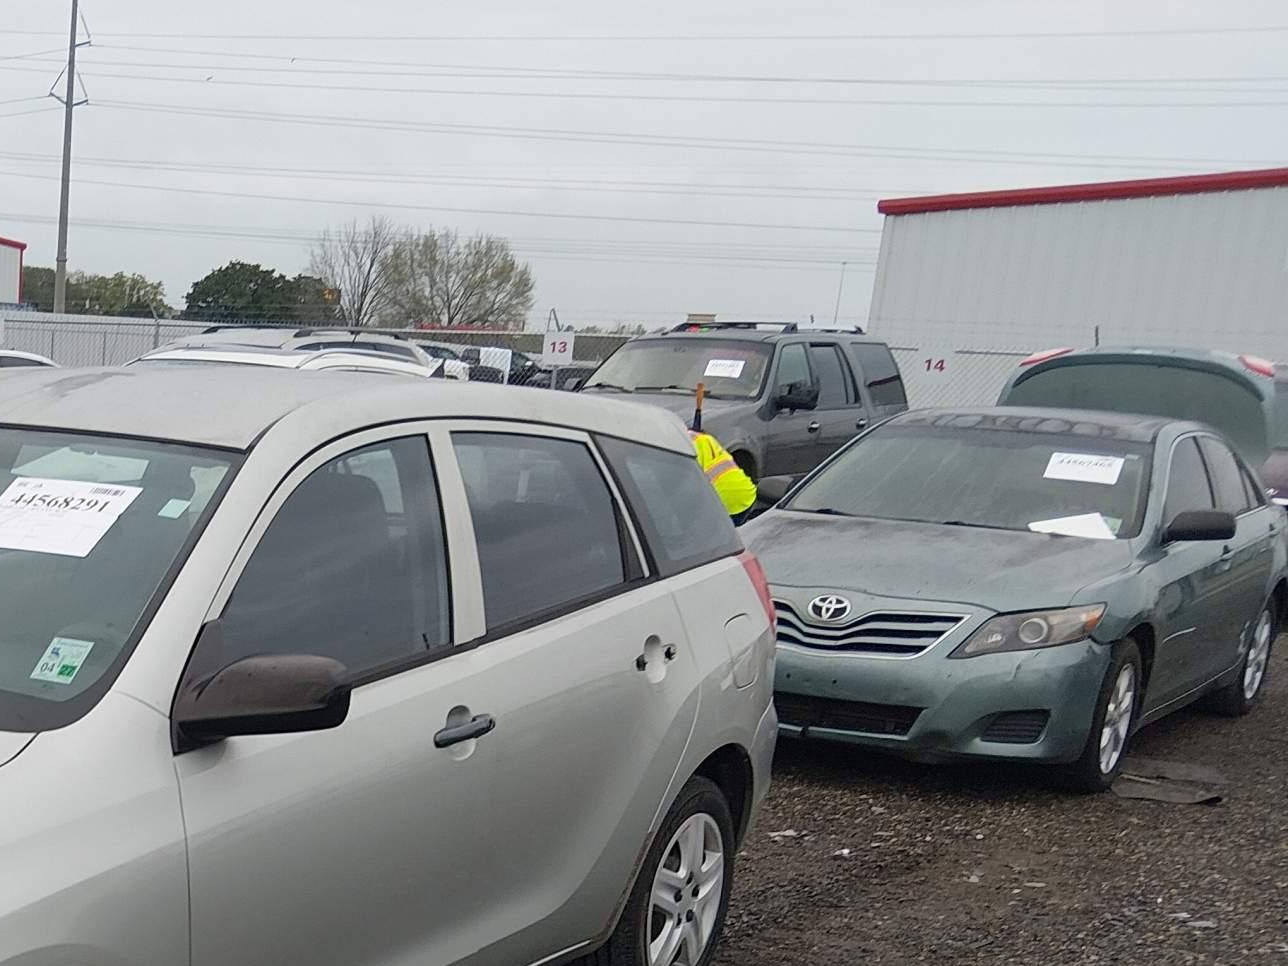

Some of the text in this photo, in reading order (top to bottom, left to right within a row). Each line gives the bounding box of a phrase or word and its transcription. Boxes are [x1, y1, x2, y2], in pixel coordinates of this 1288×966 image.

[550, 341, 568, 354] 13
[924, 358, 946, 372] 14
[11, 492, 112, 513] 44568291
